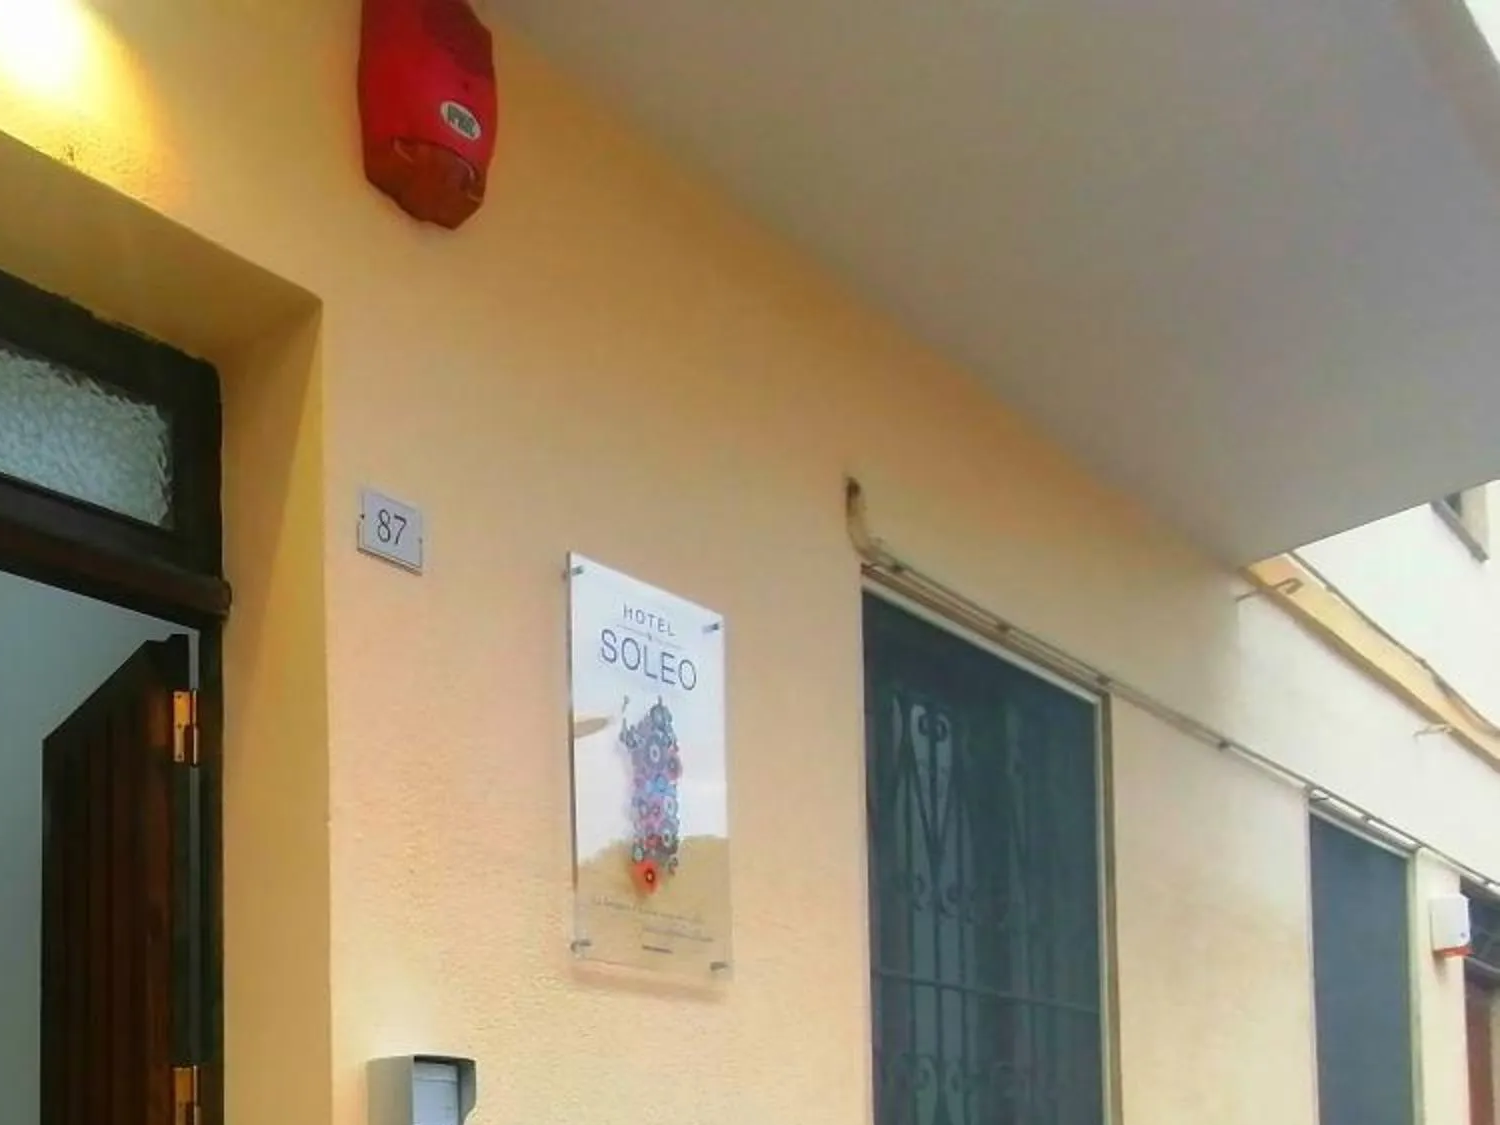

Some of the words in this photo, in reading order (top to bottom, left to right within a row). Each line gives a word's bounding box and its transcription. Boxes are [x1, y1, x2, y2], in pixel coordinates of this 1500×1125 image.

[377, 508, 408, 545] 87
[622, 602, 677, 637] HOTEL
[600, 628, 697, 691] SOLEO
